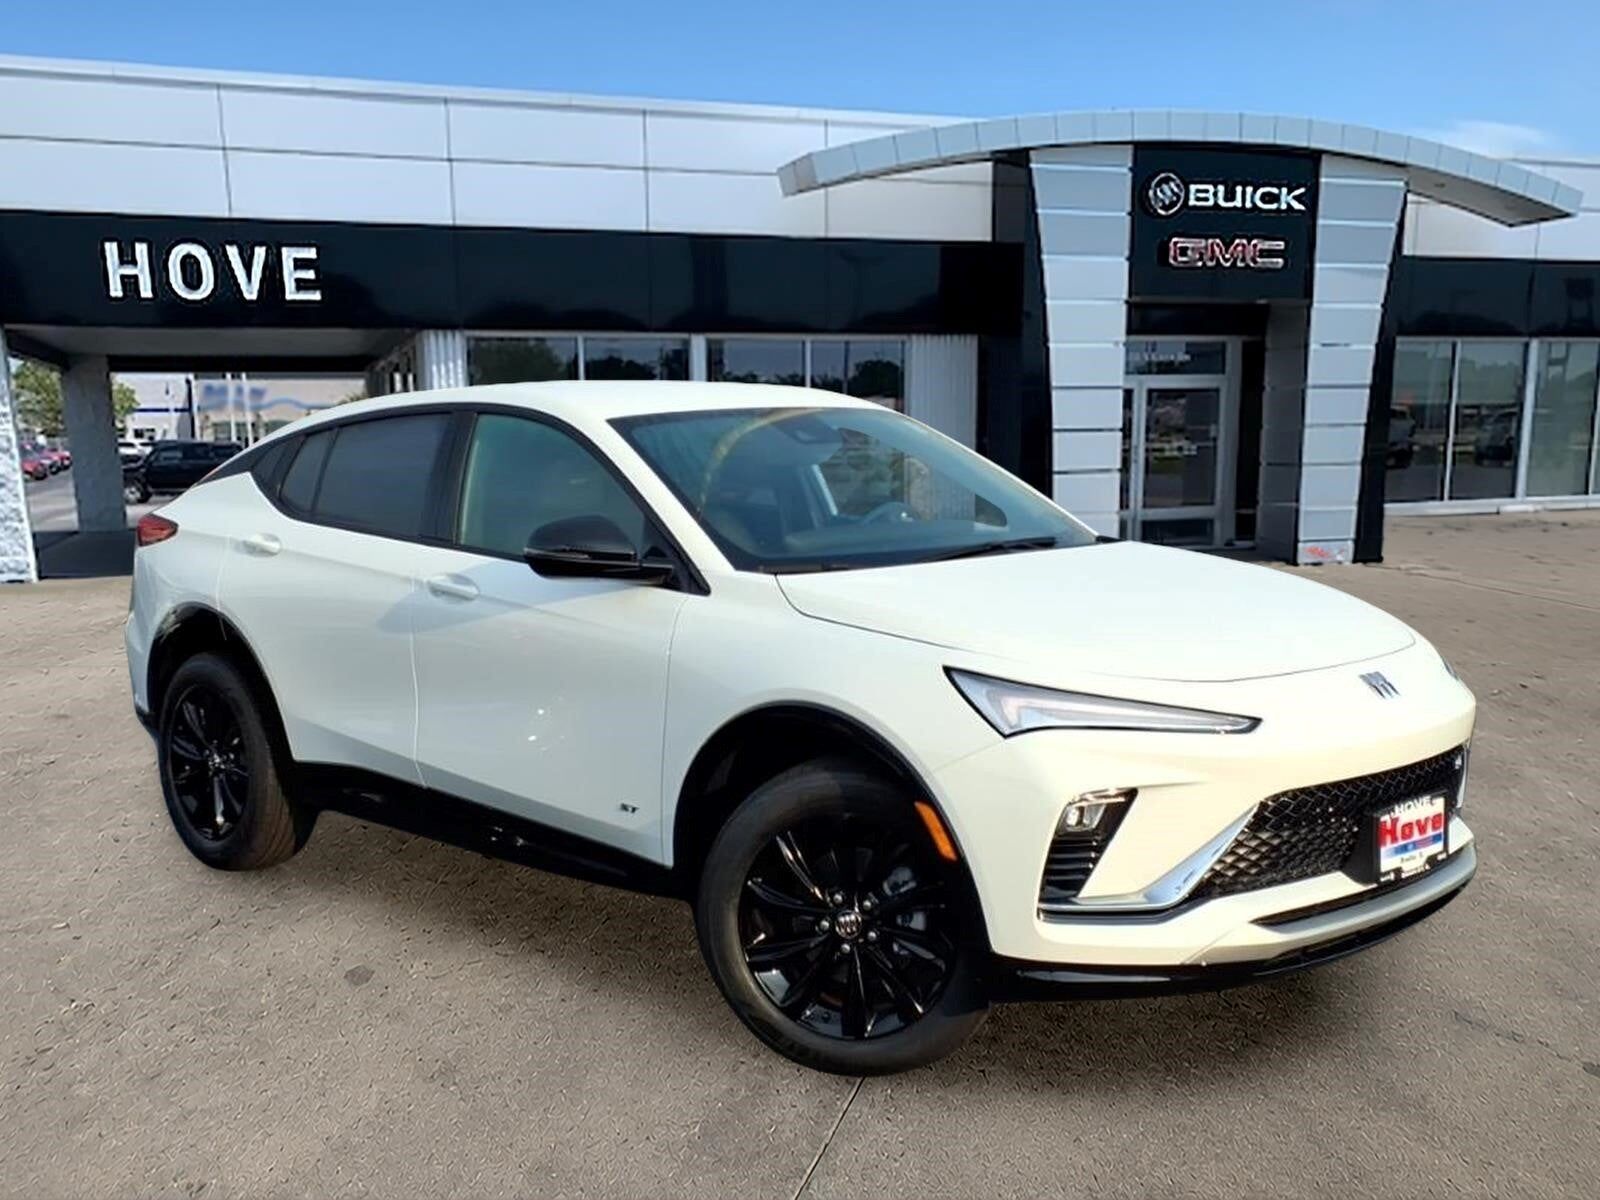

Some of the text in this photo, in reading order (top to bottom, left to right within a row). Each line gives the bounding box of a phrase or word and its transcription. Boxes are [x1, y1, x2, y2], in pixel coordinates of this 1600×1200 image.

[1188, 184, 1306, 210] BUICK
[1169, 237, 1285, 268] GMC
[104, 241, 322, 300] HOVE
